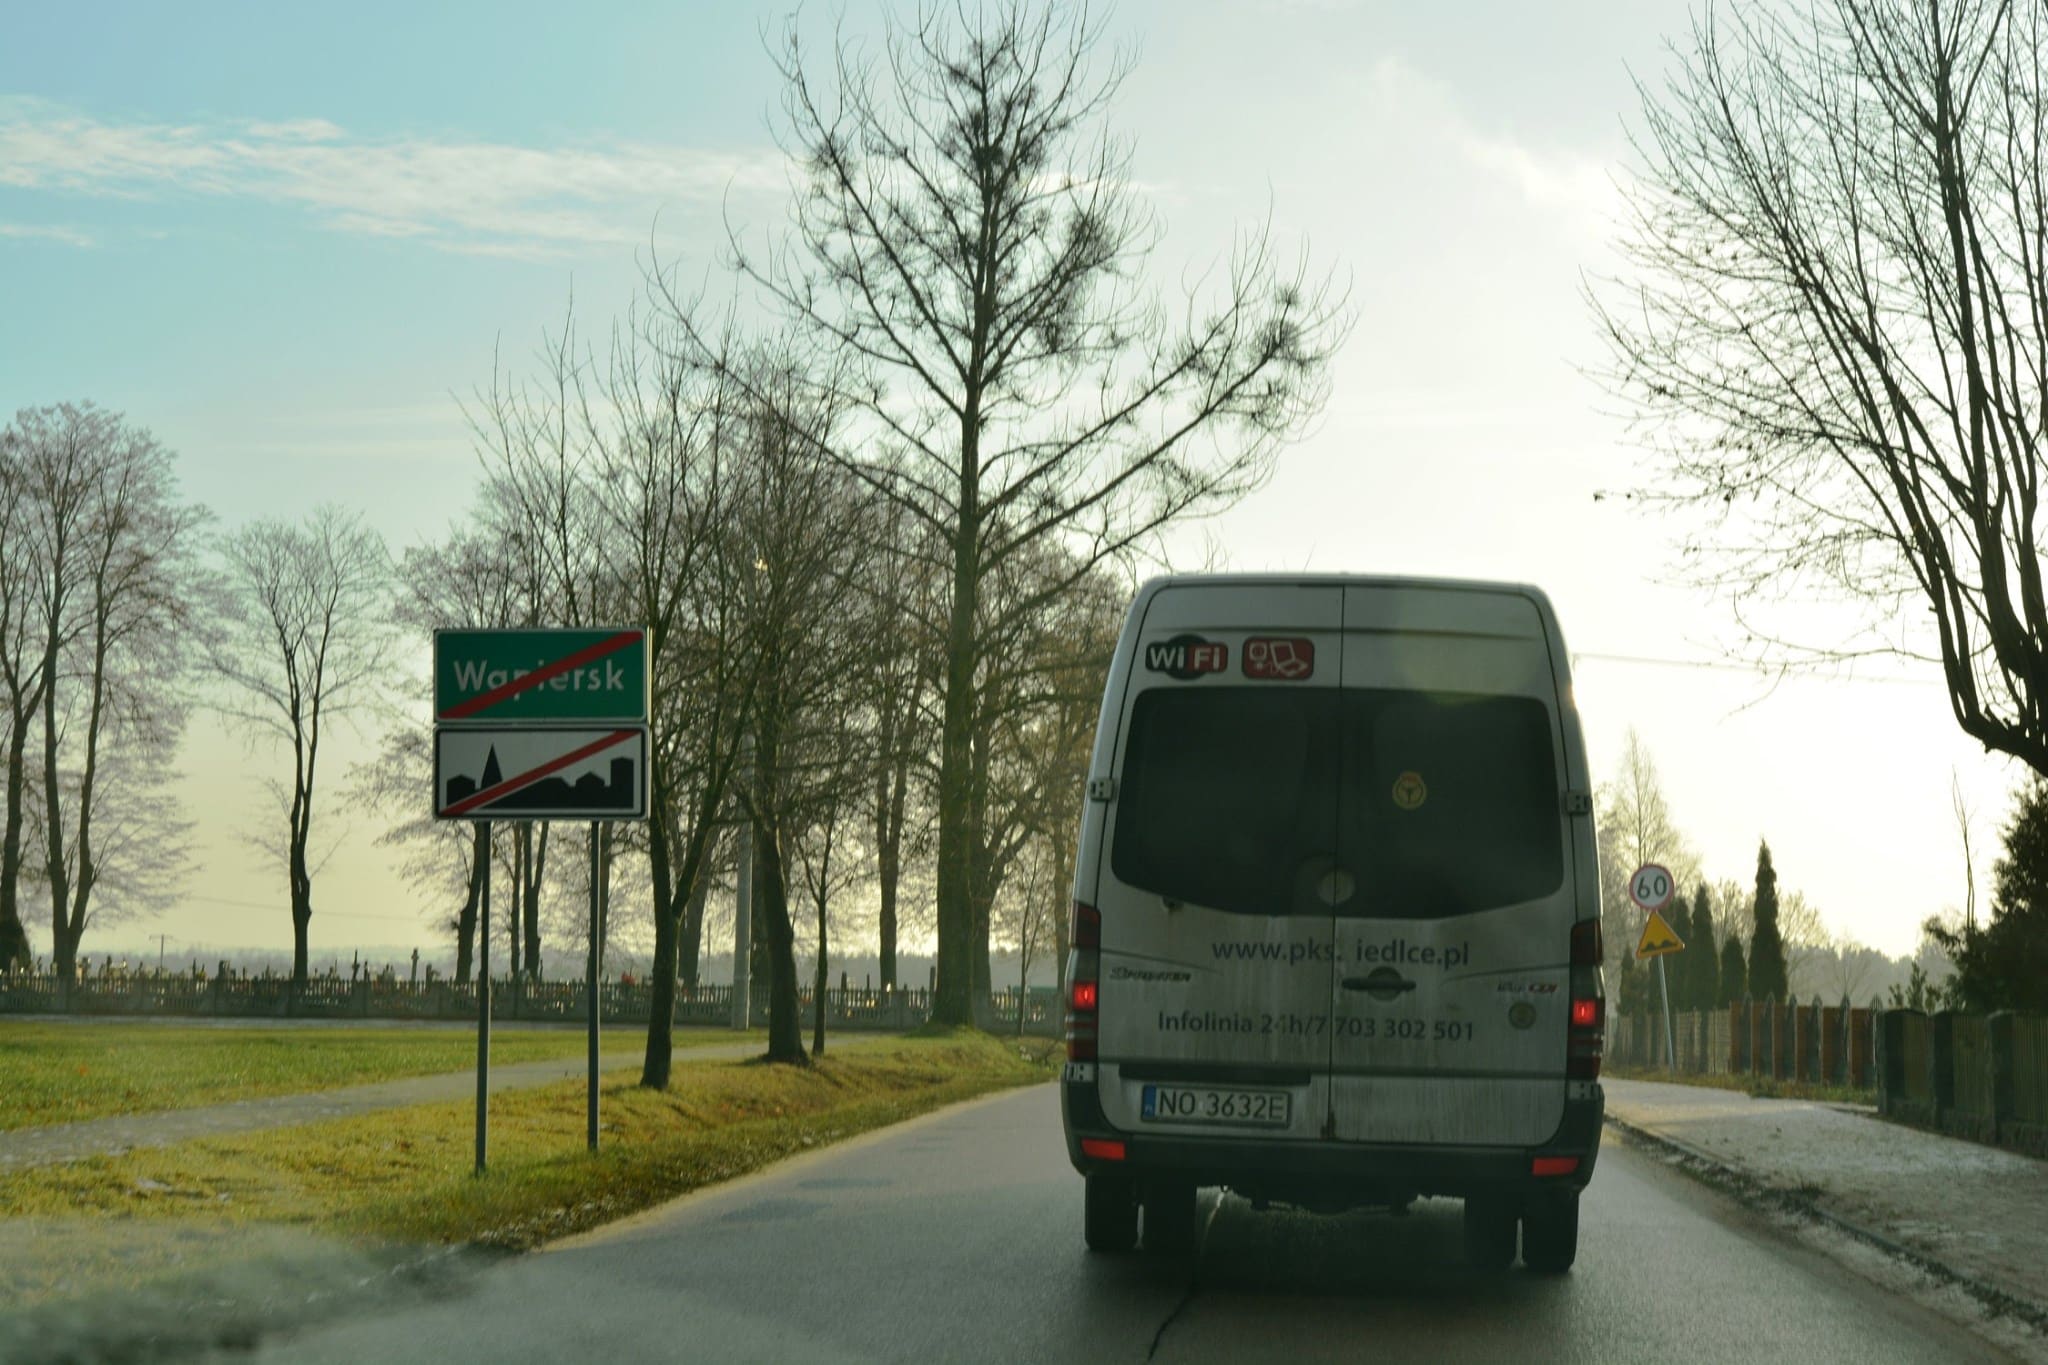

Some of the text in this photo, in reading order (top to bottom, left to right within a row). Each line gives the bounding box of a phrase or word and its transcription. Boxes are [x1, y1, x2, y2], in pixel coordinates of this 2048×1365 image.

[1637, 875, 1667, 899] 60
[1158, 1011, 1253, 1034] Infolinia
[1335, 1016, 1376, 1037] 703
[1384, 1018, 1426, 1039] 302
[1433, 1020, 1473, 1041] 501
[1159, 1090, 1196, 1115] NO
[1206, 1092, 1284, 1121] 3632E
